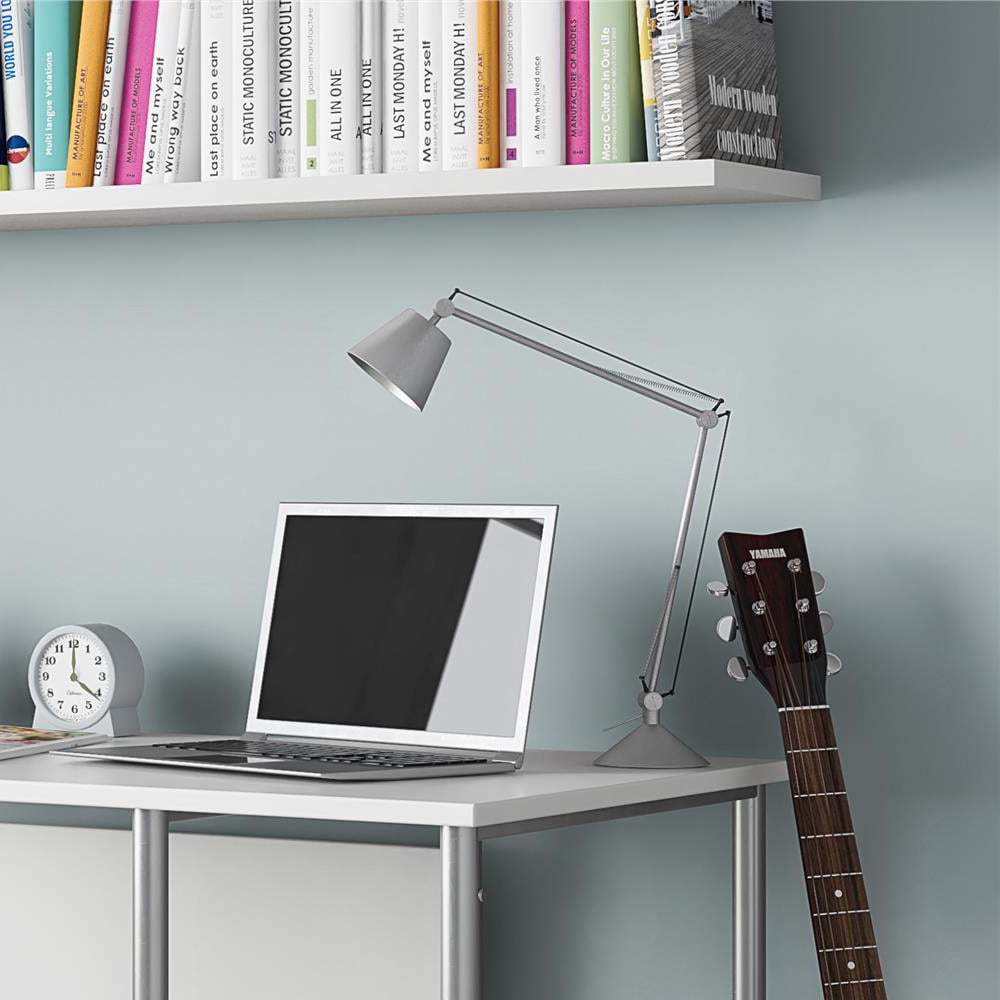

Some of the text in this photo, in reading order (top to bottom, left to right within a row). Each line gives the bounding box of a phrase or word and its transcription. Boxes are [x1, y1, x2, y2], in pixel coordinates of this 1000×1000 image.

[2, 15, 14, 43] YOU
[392, 28, 405, 42] H!
[453, 23, 466, 37] H!
[570, 18, 578, 55] MODELS
[4, 40, 17, 80] WORLD
[45, 51, 53, 97] Variations
[361, 58, 372, 89] ONE
[392, 45, 405, 104] MONDAY
[453, 41, 466, 100] MONDAY
[570, 58, 577, 69] OF
[653, 33, 681, 97] wooden
[102, 78, 111, 98] on
[330, 68, 342, 98] ONE
[533, 78, 541, 96] lived
[600, 26, 612, 161] Macro Culture In Our Life
[708, 74, 777, 117] Modern wooden
[164, 47, 185, 174] Wrong way back
[209, 40, 220, 177] Last place on earth
[278, 87, 293, 137] STATIC
[330, 100, 342, 114] IN
[361, 92, 372, 107] IN
[422, 40, 433, 163] Me and myself
[533, 97, 541, 113] who
[72, 98, 84, 162] MANUFACTURE
[78, 83, 86, 95] OF
[97, 102, 109, 145] place
[126, 106, 138, 164] MANUFACTURE
[132, 67, 142, 92] MODELS
[145, 57, 165, 174] Me and myself
[242, 101, 255, 145] STATIC
[330, 116, 342, 141] ALL
[361, 111, 372, 136] ALL
[392, 107, 405, 139] LAST
[453, 103, 466, 135] LAST
[533, 114, 541, 132] Man
[658, 98, 687, 161] Modern
[45, 129, 53, 157] Multi
[716, 127, 777, 161] constructions
[748, 547, 787, 560] YAMAHA
[45, 656, 56, 665] 10
[55, 644, 65, 653] 11
[94, 656, 102, 665] 2
[42, 671, 50, 681] 9
[98, 671, 106, 681] 3
[46, 688, 54, 697] 8
[57, 700, 65, 709] 7
[85, 700, 93, 709] 5
[71, 704, 79, 714] 6
